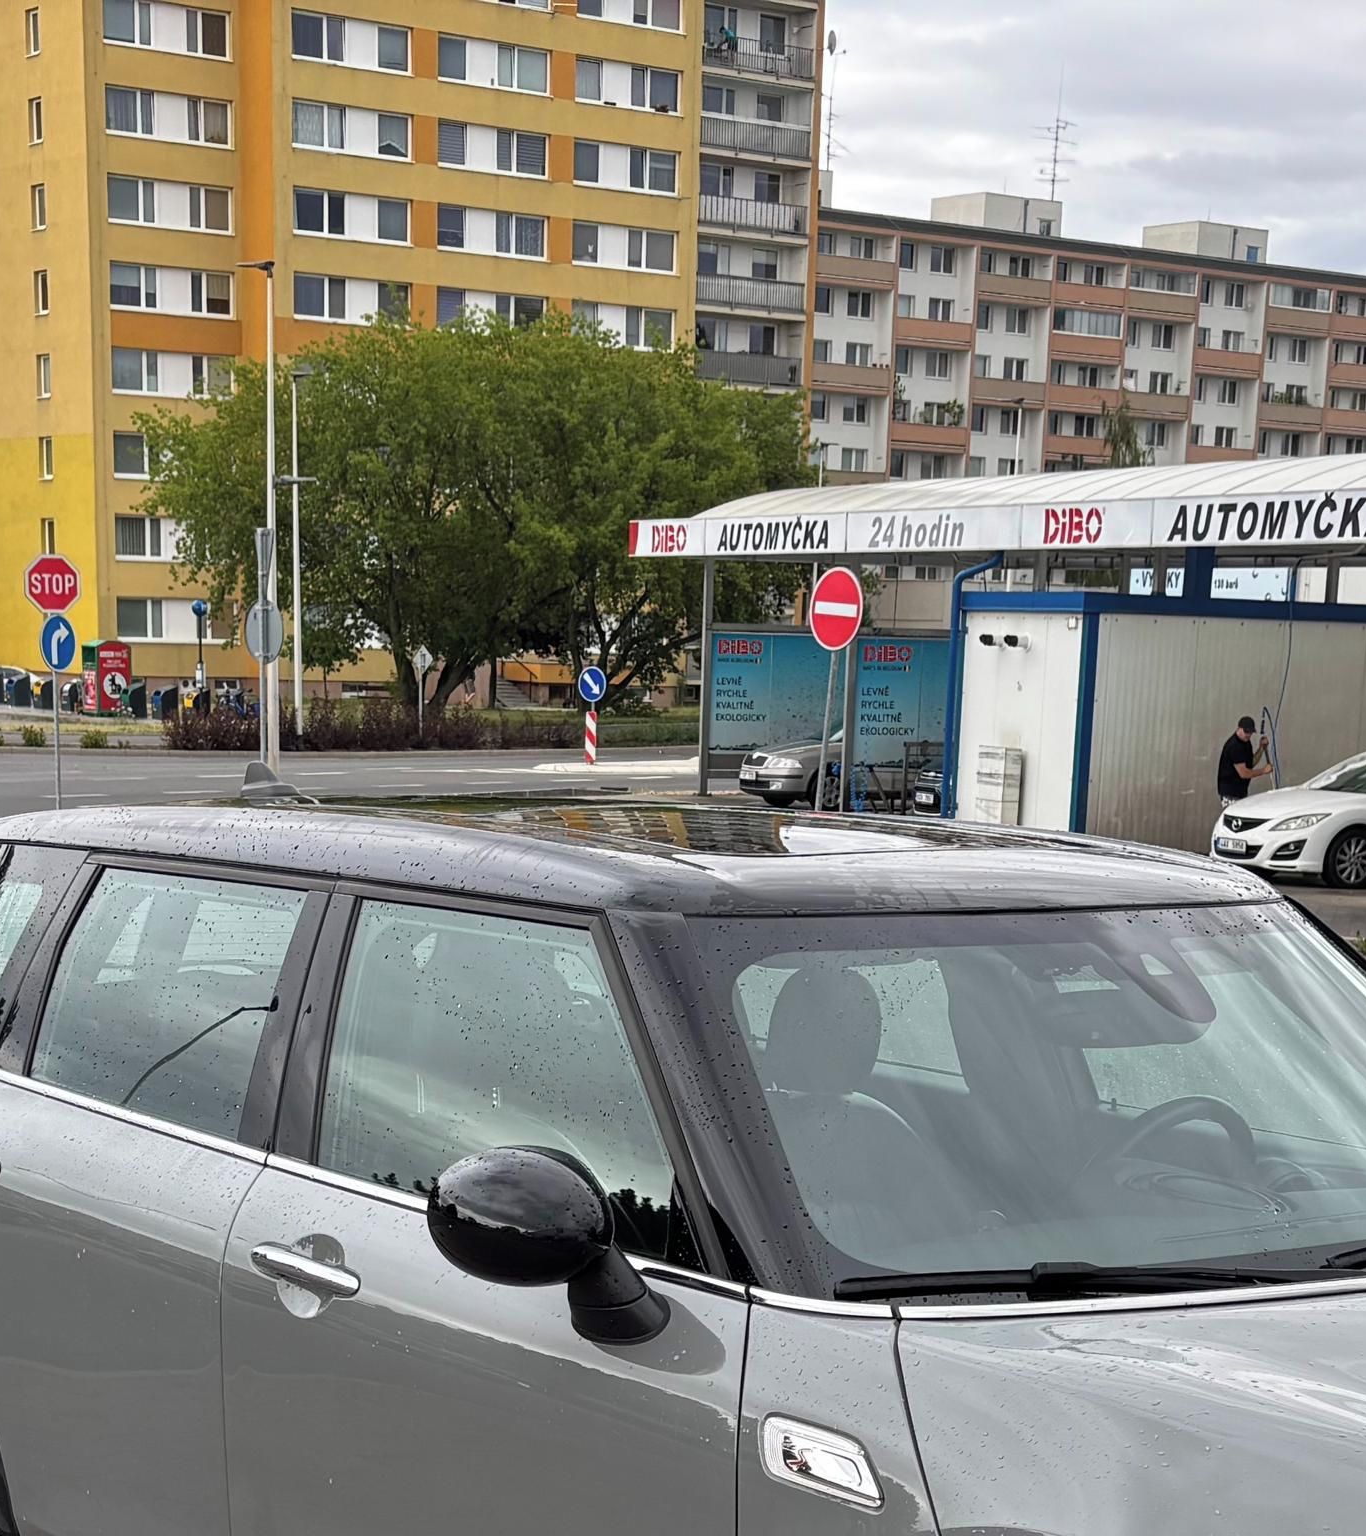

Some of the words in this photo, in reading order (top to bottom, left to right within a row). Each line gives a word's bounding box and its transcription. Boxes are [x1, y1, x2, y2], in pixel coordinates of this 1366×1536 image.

[717, 515, 829, 552] AUTOMYČKA
[868, 516, 896, 548] 24
[899, 514, 964, 548] hodin
[30, 573, 75, 595] STOP
[716, 676, 742, 686] LEVNĚ
[716, 689, 747, 698] RYCHLE
[861, 687, 890, 697] LEVNĚ
[715, 700, 755, 710] KVALITNĚ
[861, 701, 895, 709] RYCHLE
[715, 713, 767, 722] EKOLOGICKY
[860, 712, 902, 723] KVALITNĚ
[860, 726, 915, 736] EKOLOGICKY
